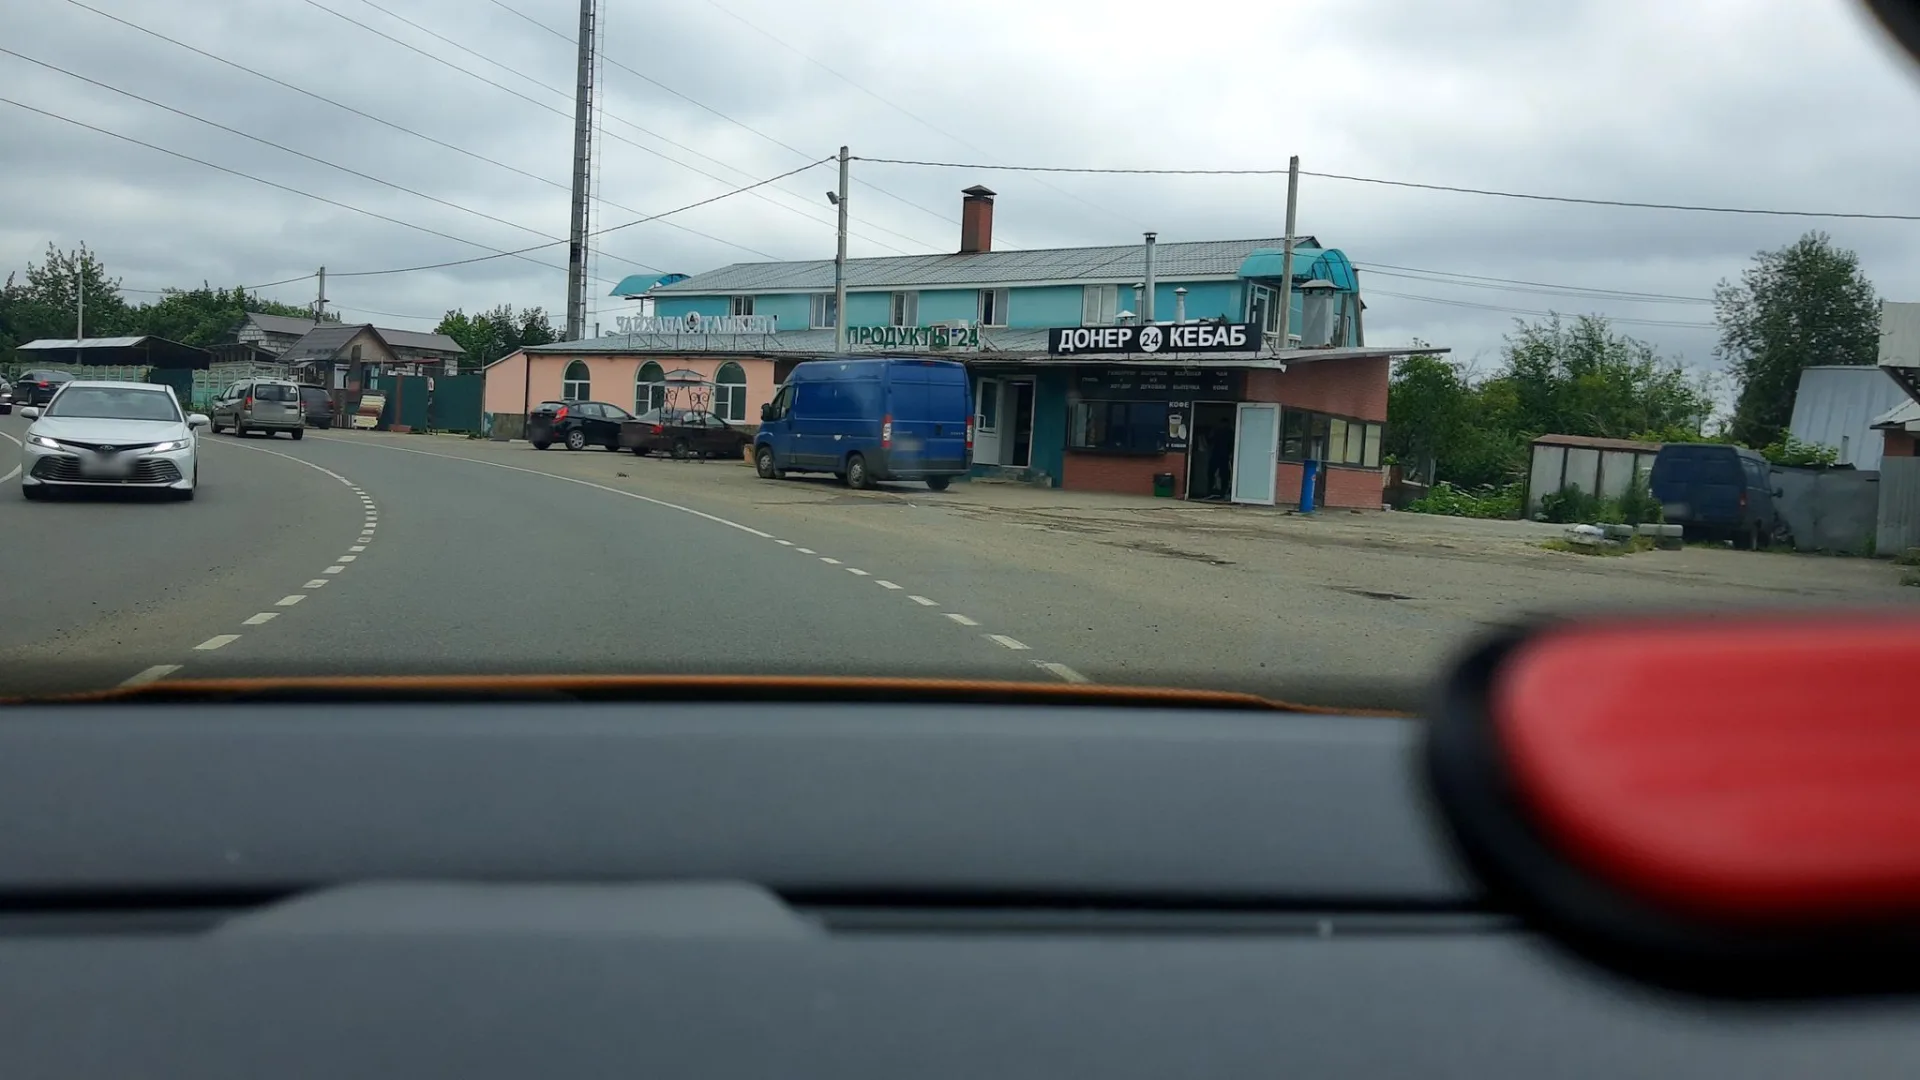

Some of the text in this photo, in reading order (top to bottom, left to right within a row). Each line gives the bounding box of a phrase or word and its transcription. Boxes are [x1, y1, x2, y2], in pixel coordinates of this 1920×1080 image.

[847, 326, 949, 349] ПРОДУКТЫ
[1058, 325, 1247, 352] ДОНЕР 24 КЕБАБ
